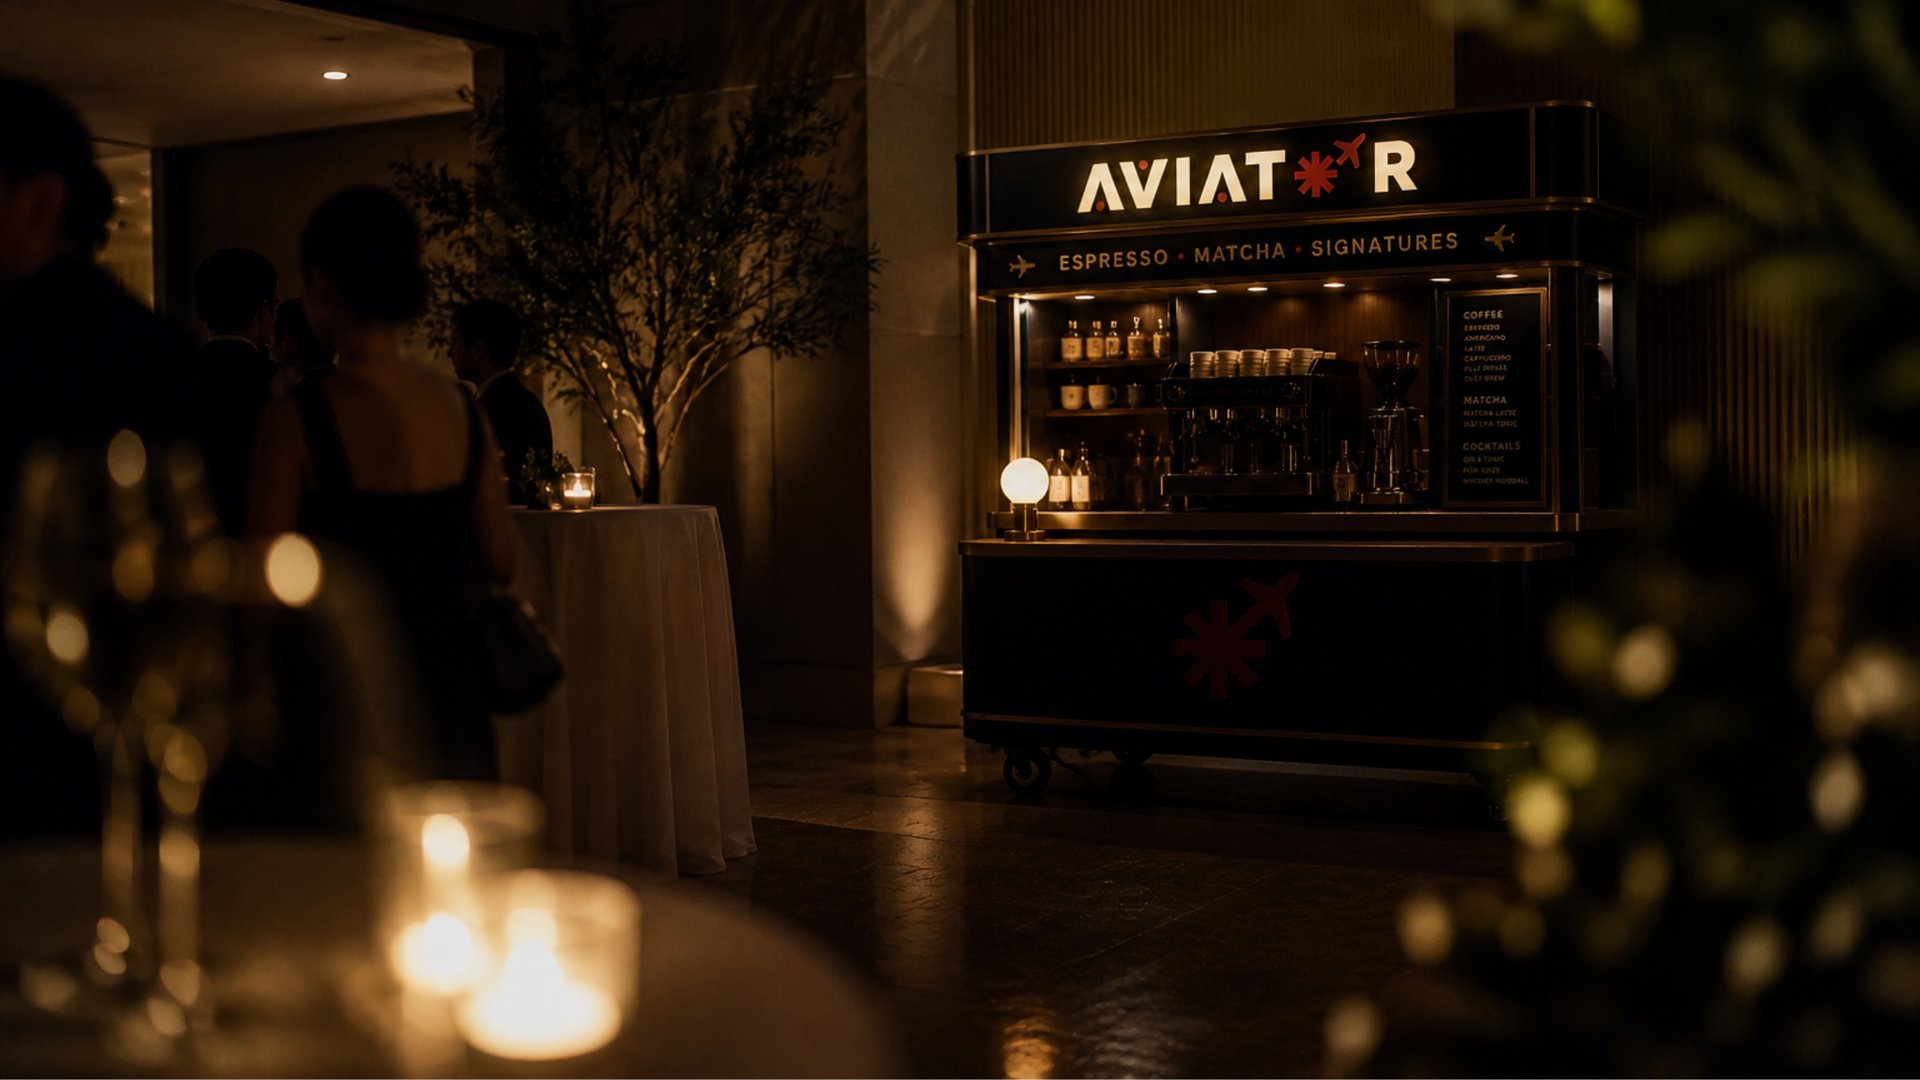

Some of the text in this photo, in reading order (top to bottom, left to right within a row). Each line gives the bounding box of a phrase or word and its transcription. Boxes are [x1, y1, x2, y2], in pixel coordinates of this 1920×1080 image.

[1059, 232, 1458, 272] ESPRESSO MATCHA SIGNATURES
[1463, 309, 1504, 320] COFFEE
[1463, 395, 1507, 405] MATCHA
[1462, 441, 1521, 451] COCKTAILS
